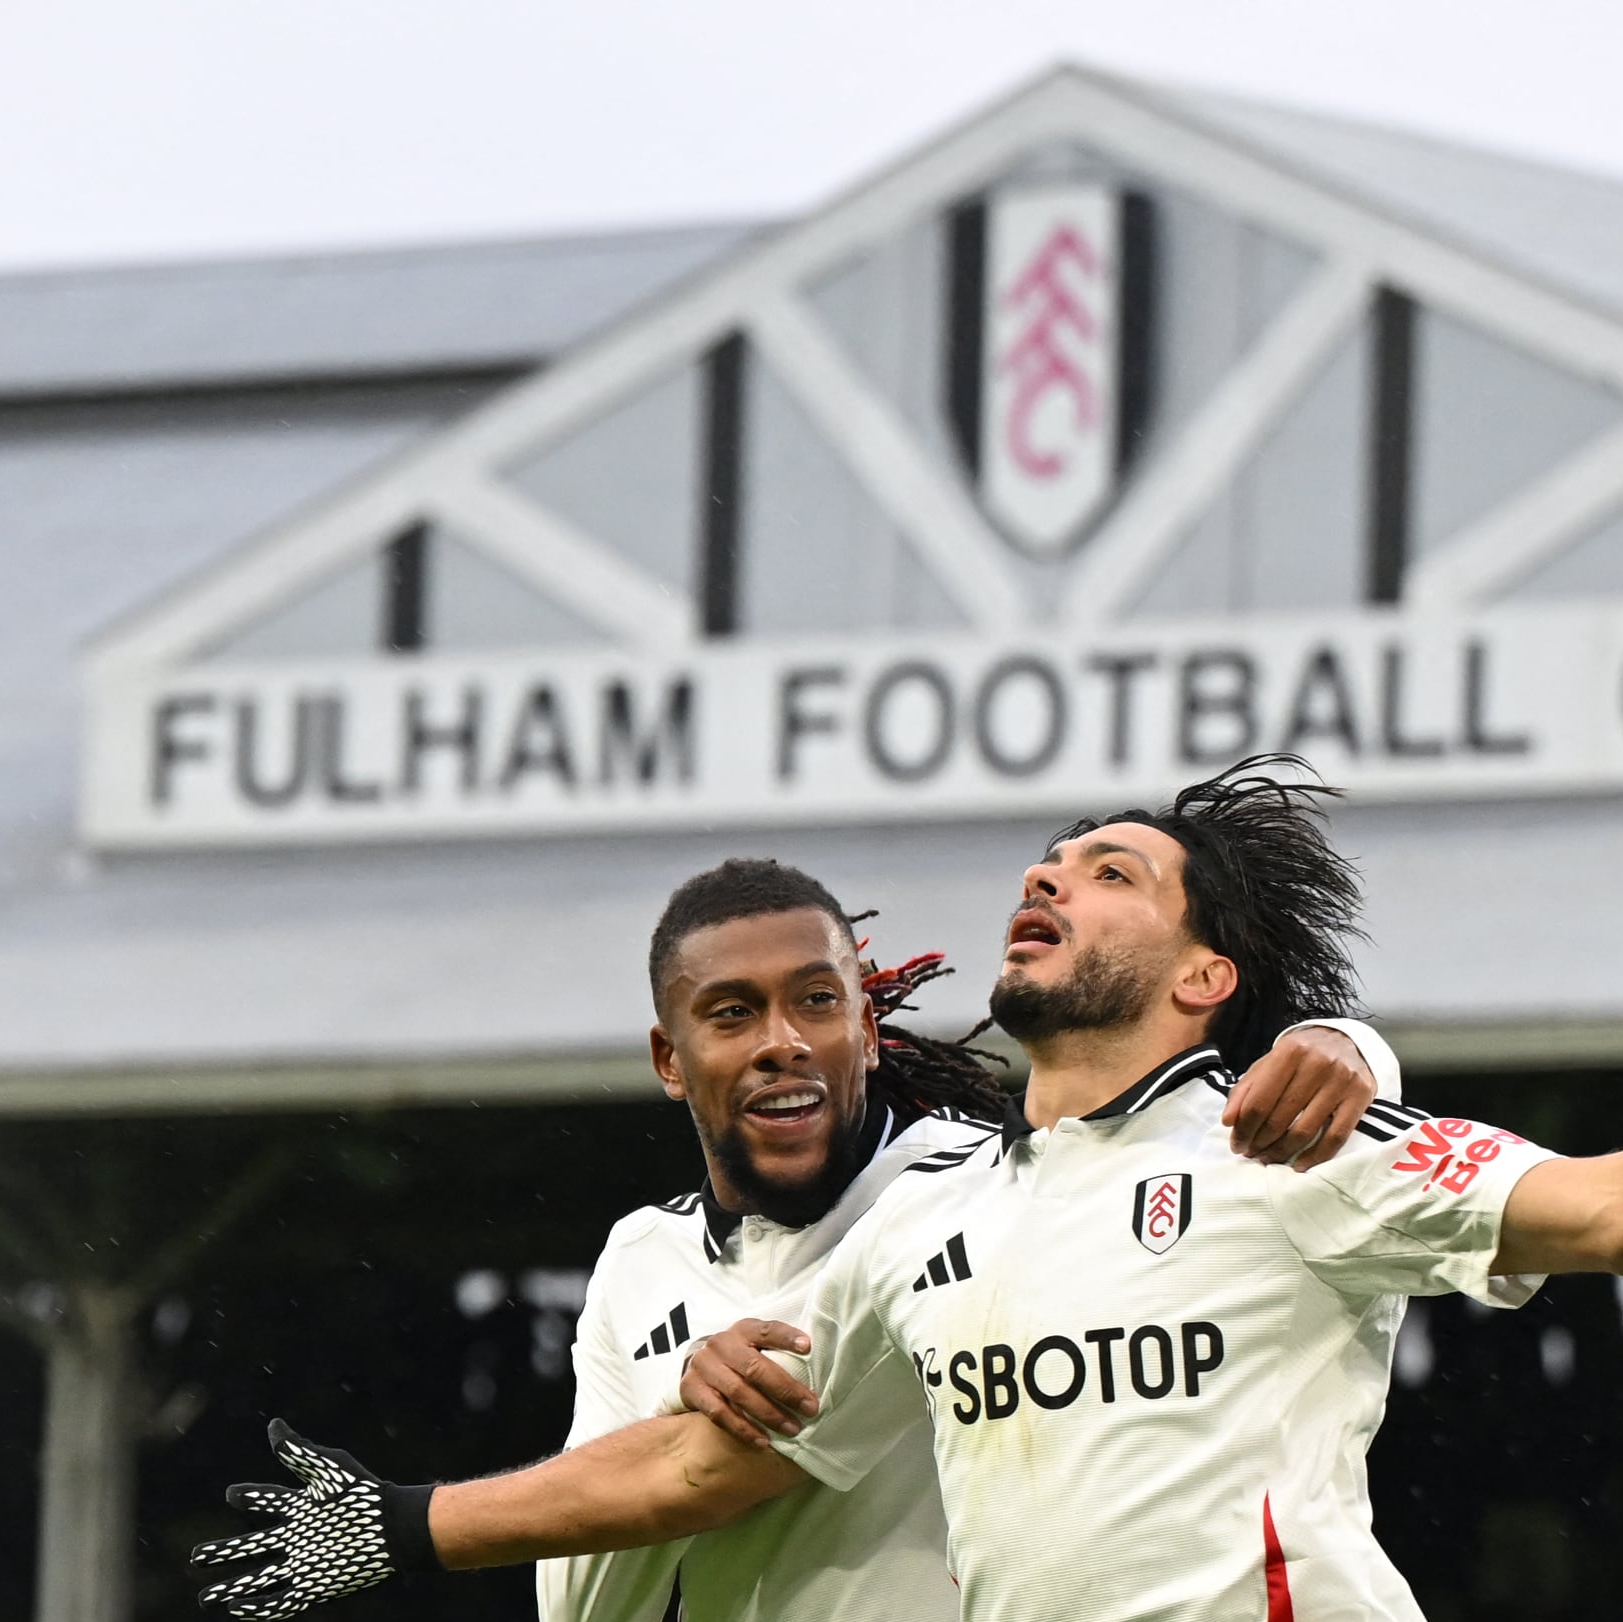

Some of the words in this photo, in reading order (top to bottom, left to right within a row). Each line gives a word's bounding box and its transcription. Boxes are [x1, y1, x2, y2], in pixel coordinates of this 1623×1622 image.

[146, 673, 699, 808] FULHAM
[778, 636, 1532, 786] FOOTBALL
[949, 1320, 1225, 1426] SBOTOP
